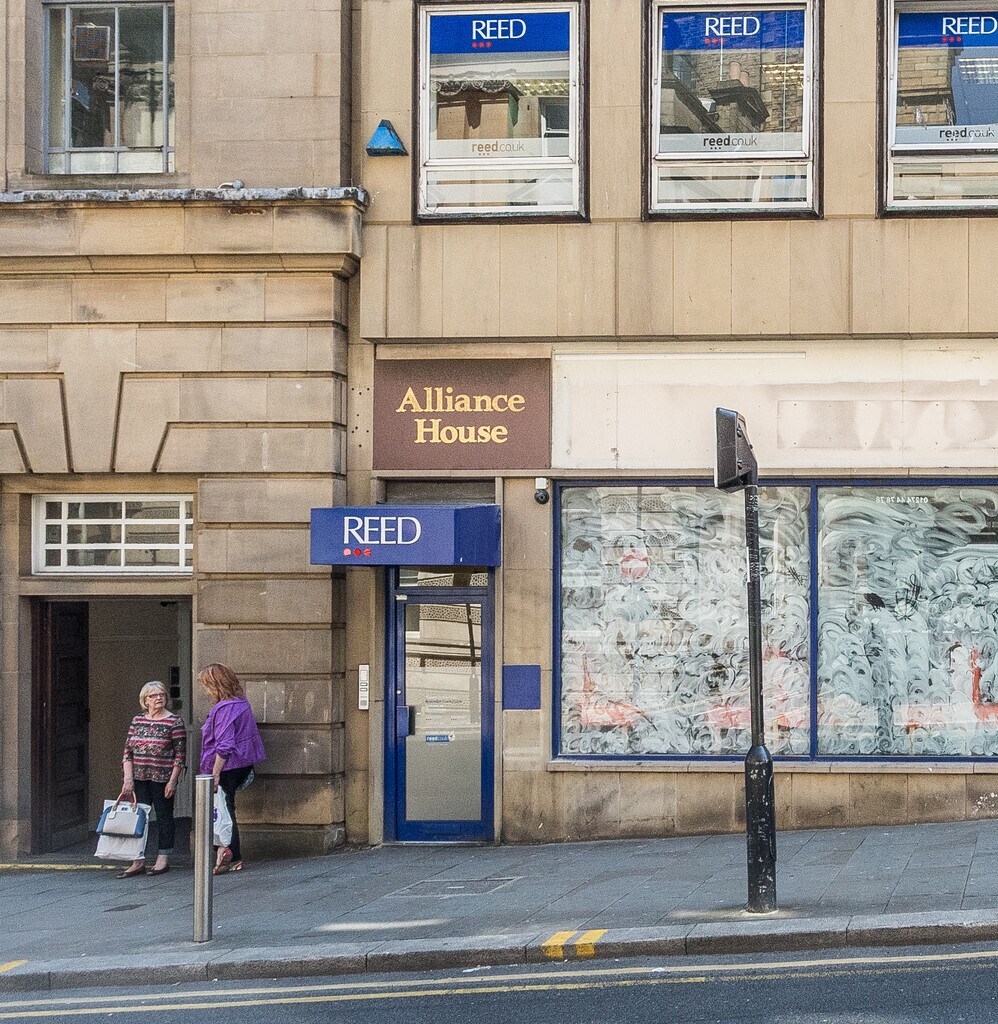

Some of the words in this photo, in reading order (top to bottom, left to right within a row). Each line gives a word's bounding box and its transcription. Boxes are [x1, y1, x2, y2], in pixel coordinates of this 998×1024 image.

[472, 19, 527, 40] REED
[705, 16, 760, 36] REED
[942, 16, 998, 35] REED
[396, 386, 526, 412] Alliance
[414, 418, 508, 444] House
[343, 516, 422, 545] REED
